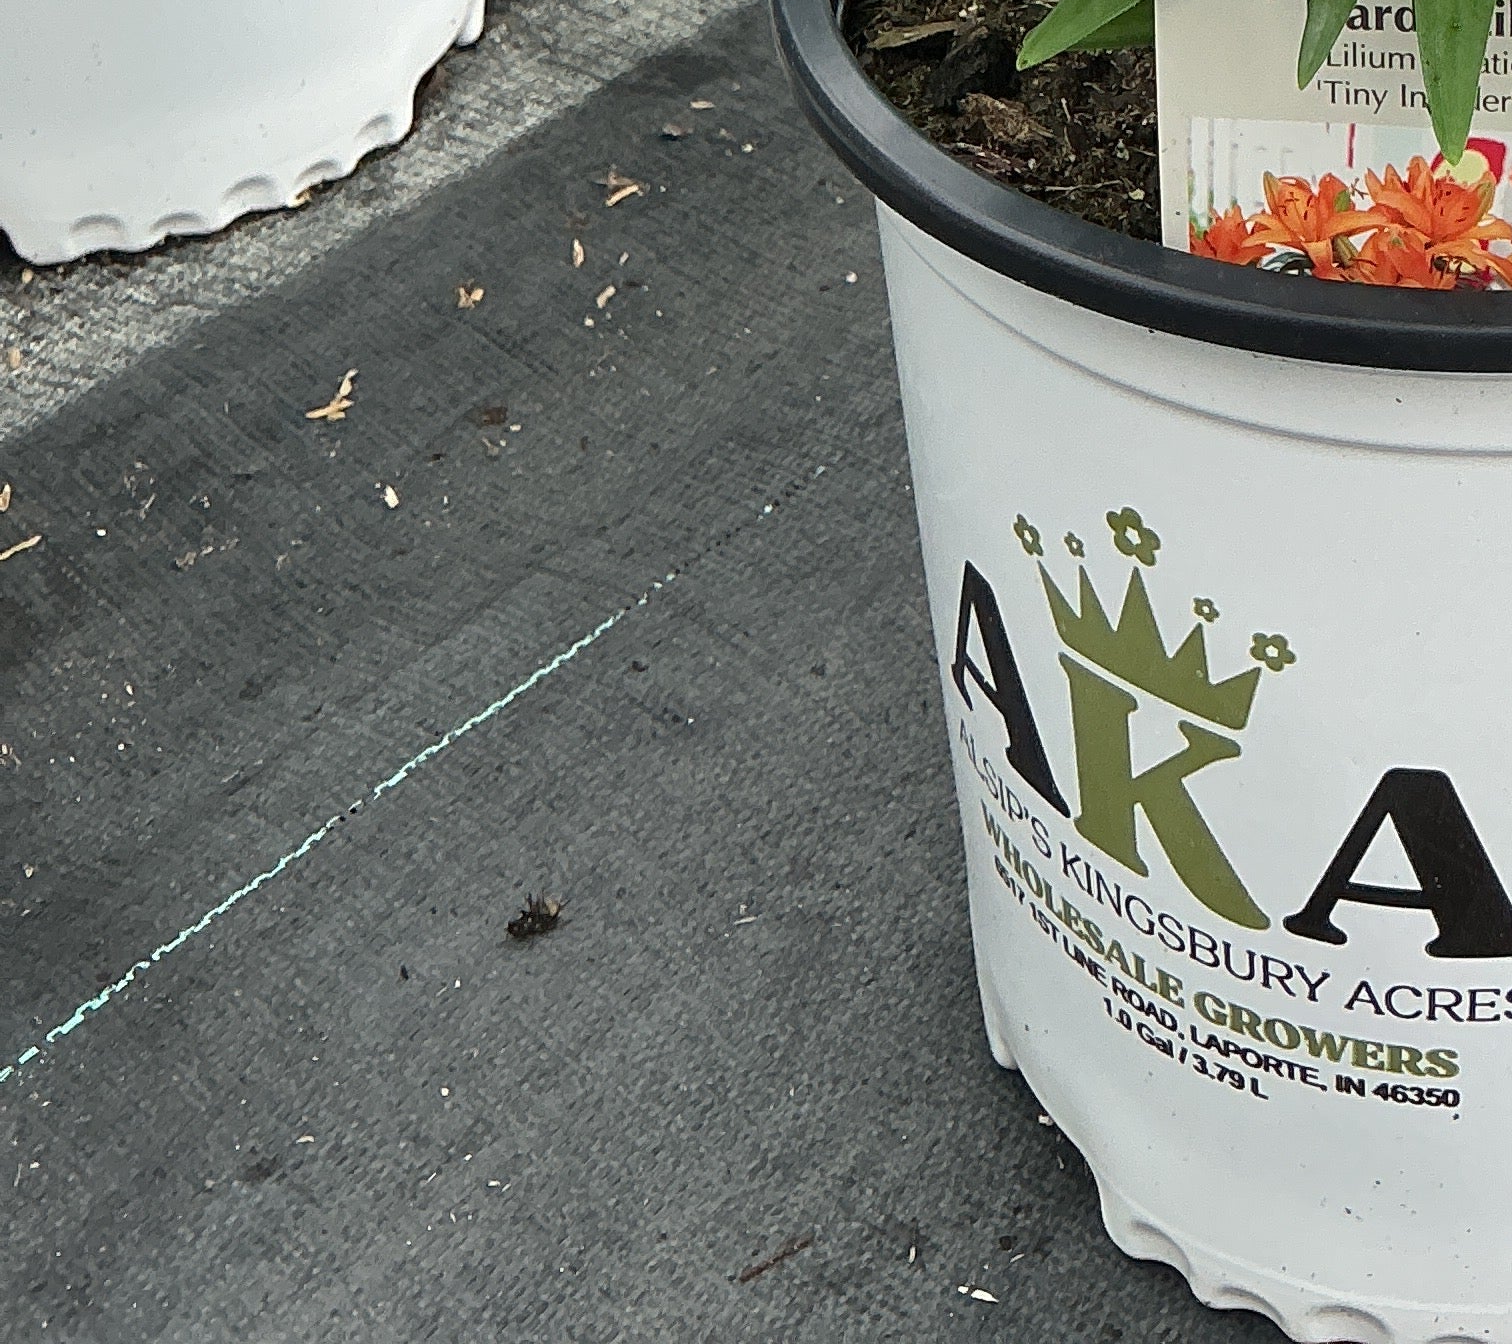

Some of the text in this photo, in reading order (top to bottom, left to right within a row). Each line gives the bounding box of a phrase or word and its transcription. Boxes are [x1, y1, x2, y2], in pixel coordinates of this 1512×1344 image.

[959, 717, 1052, 860] ALSIP'S
[1060, 840, 1331, 1003] KINGSBURY
[980, 798, 1461, 1079] WHOLESALE GROWERS
[1028, 900, 1061, 944] 1ST
[1062, 933, 1109, 989] LINE
[1188, 1023, 1328, 1092] LAPORTE,
[1335, 1073, 1367, 1098] IN
[1371, 1082, 1461, 1109] 46350
[1102, 996, 1270, 1101] 1.0 Gal / 3.79 L
